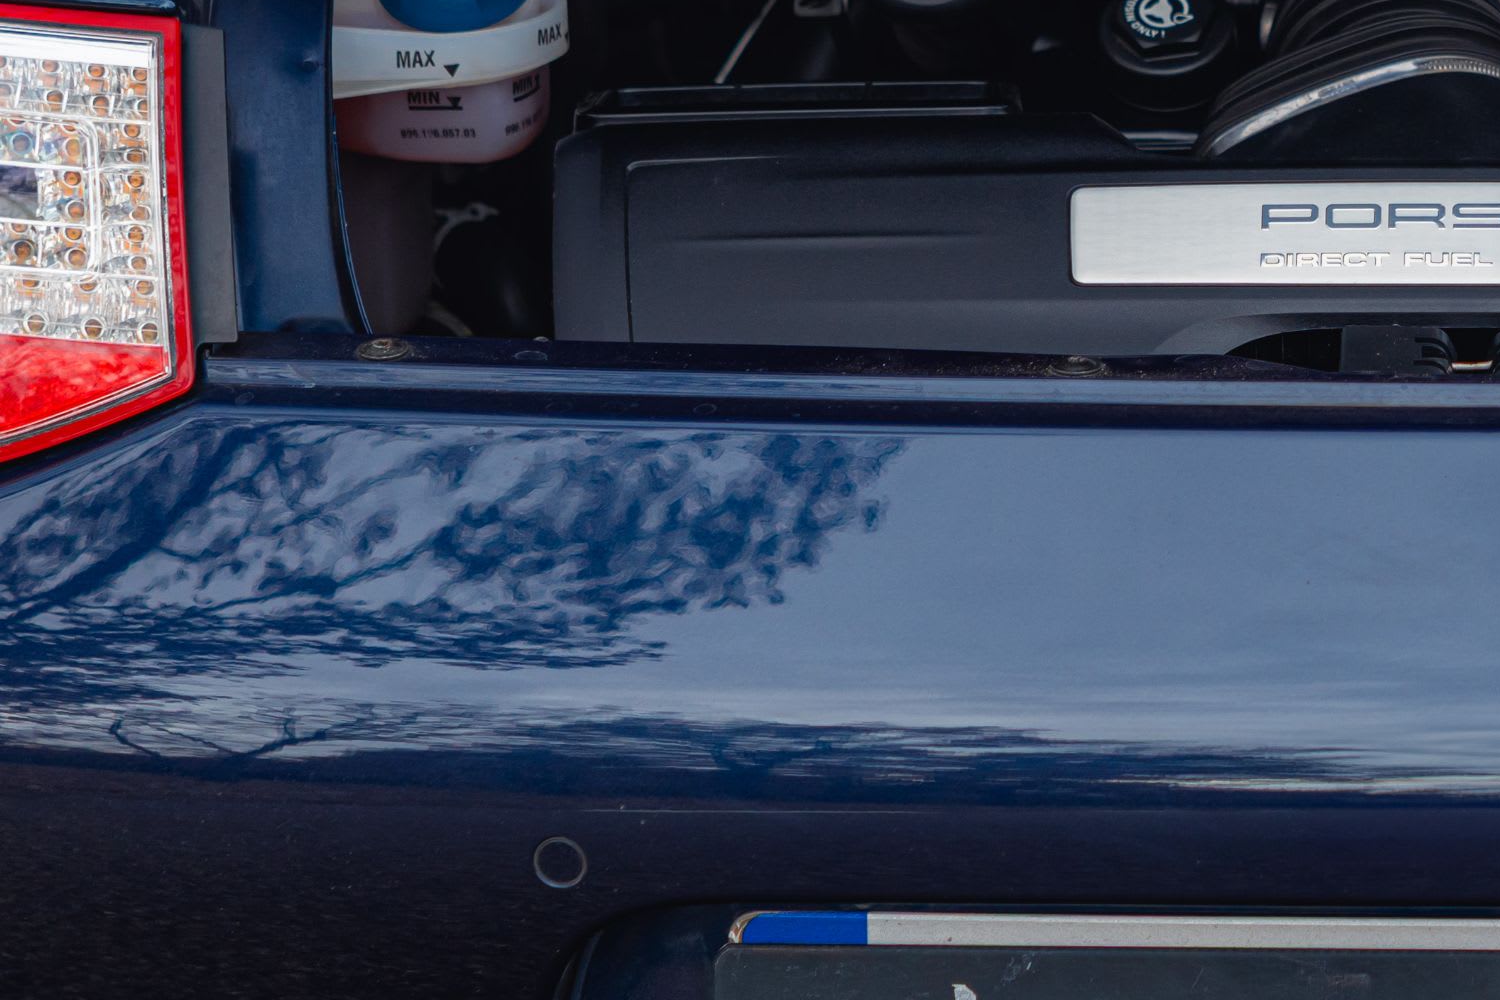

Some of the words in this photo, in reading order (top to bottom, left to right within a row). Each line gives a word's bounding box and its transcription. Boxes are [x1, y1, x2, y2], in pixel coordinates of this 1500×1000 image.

[537, 23, 563, 46] MAX
[396, 50, 436, 69] MAX
[407, 91, 441, 105] MIN
[1260, 252, 1390, 268] DIRECT
[1404, 252, 1494, 268] FUEL
